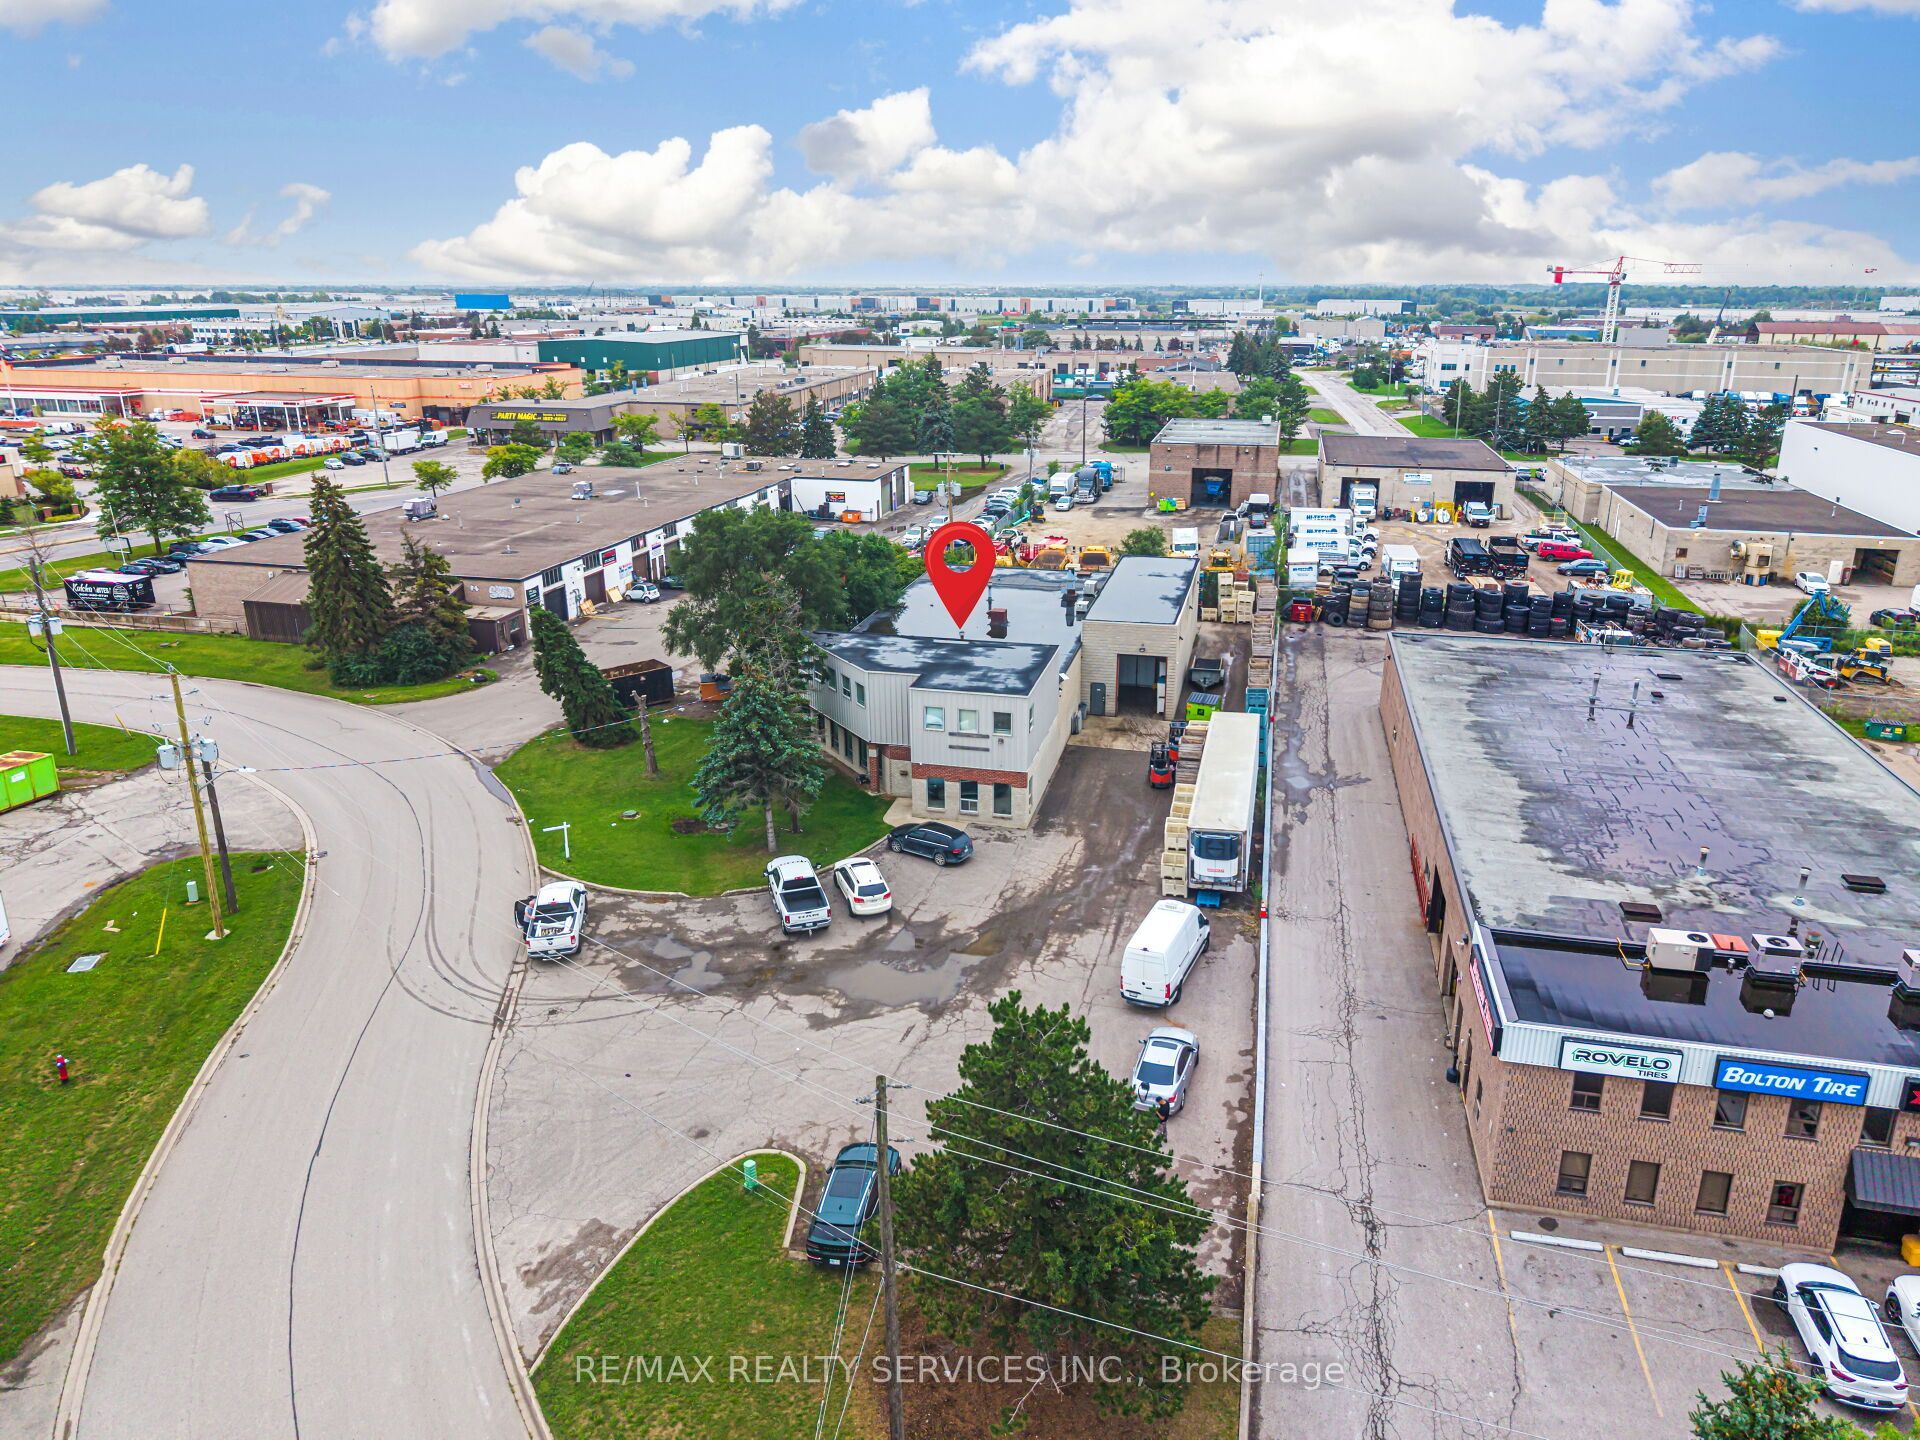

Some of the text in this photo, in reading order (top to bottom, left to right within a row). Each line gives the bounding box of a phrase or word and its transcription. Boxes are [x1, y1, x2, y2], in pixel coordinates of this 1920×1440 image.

[517, 412, 537, 420] MAGIC
[1574, 1049, 1671, 1070] ROVELO
[1637, 1069, 1669, 1079] TIRES
[1722, 1066, 1862, 1098] BOLTON TIRE
